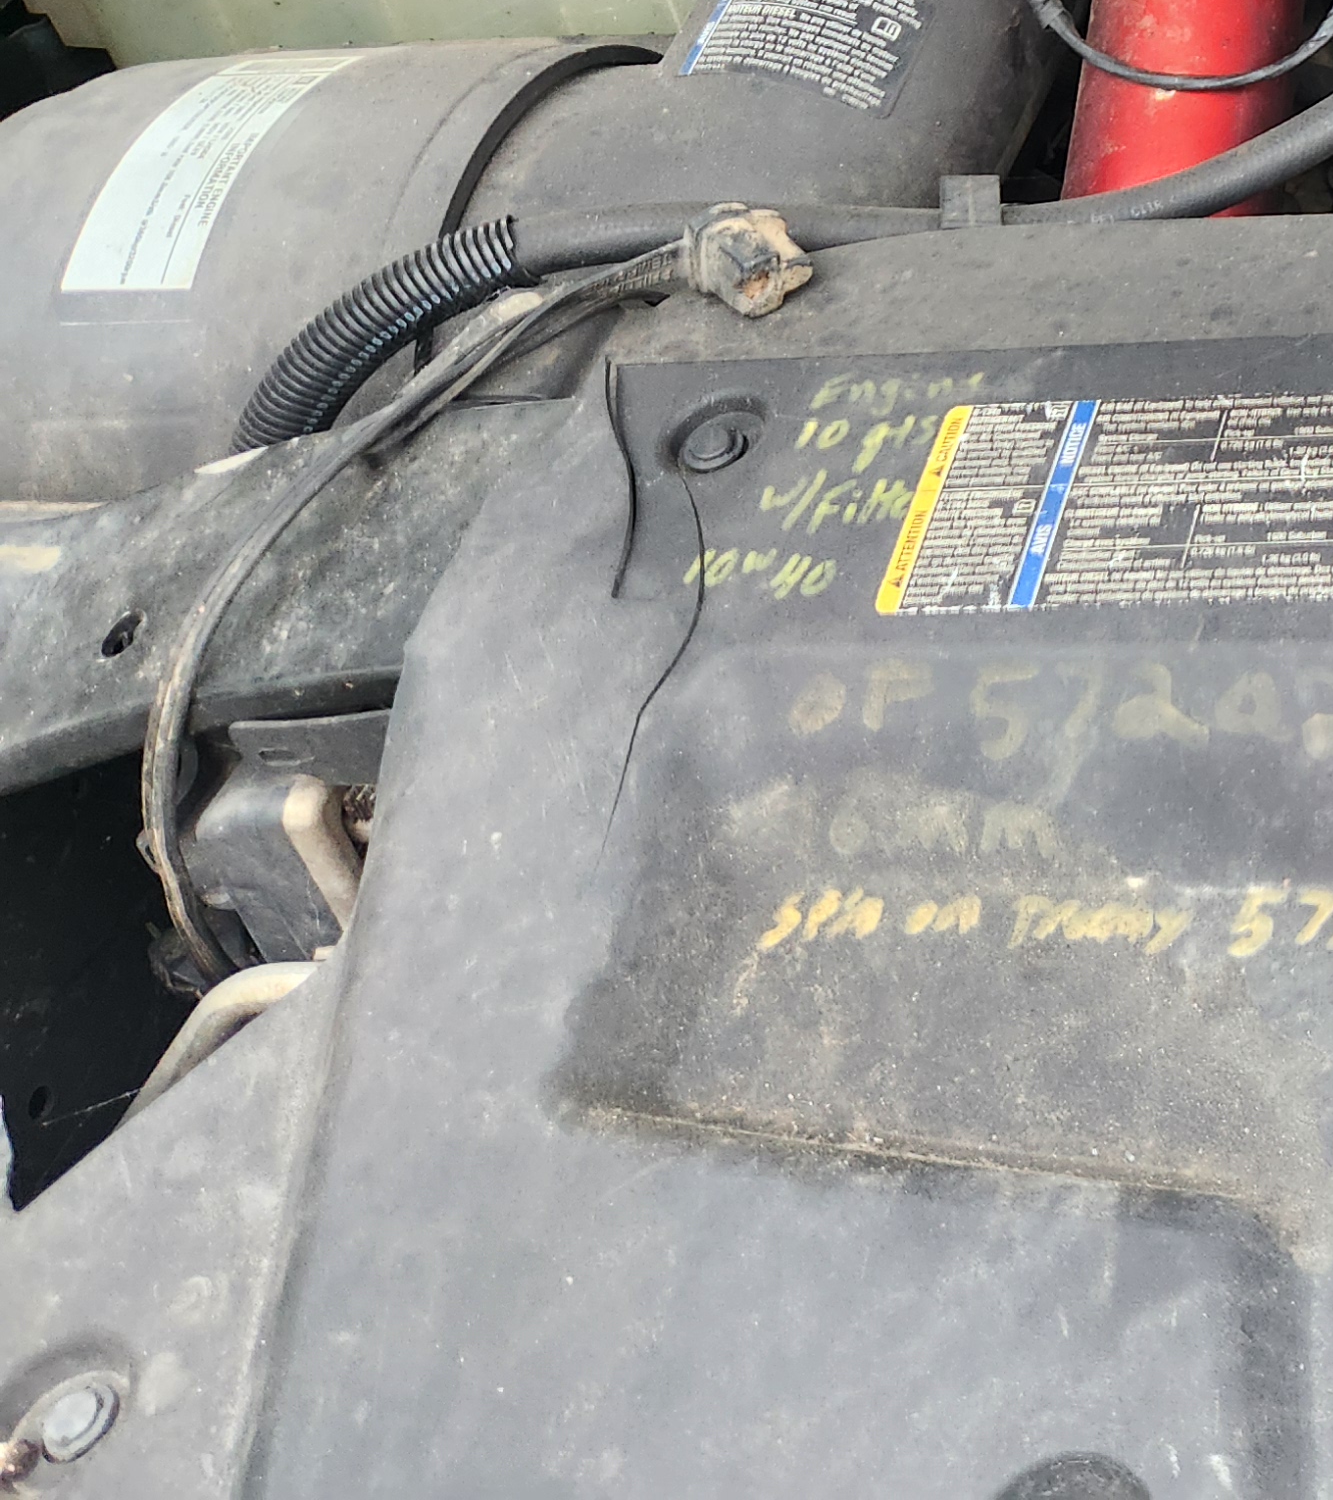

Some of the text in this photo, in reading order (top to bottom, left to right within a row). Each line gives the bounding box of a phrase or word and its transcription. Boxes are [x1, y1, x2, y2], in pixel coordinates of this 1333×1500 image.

[761, 4, 797, 19] DIESEL
[194, 143, 241, 209] INFORMATION
[197, 188, 225, 227] ENGINE
[794, 418, 850, 451] 10
[941, 417, 964, 462] CAUTION
[1060, 422, 1087, 467] NOTICE
[759, 467, 914, 536] w/Filte
[895, 509, 928, 572] ATTENTION
[1031, 523, 1054, 556] AVIS
